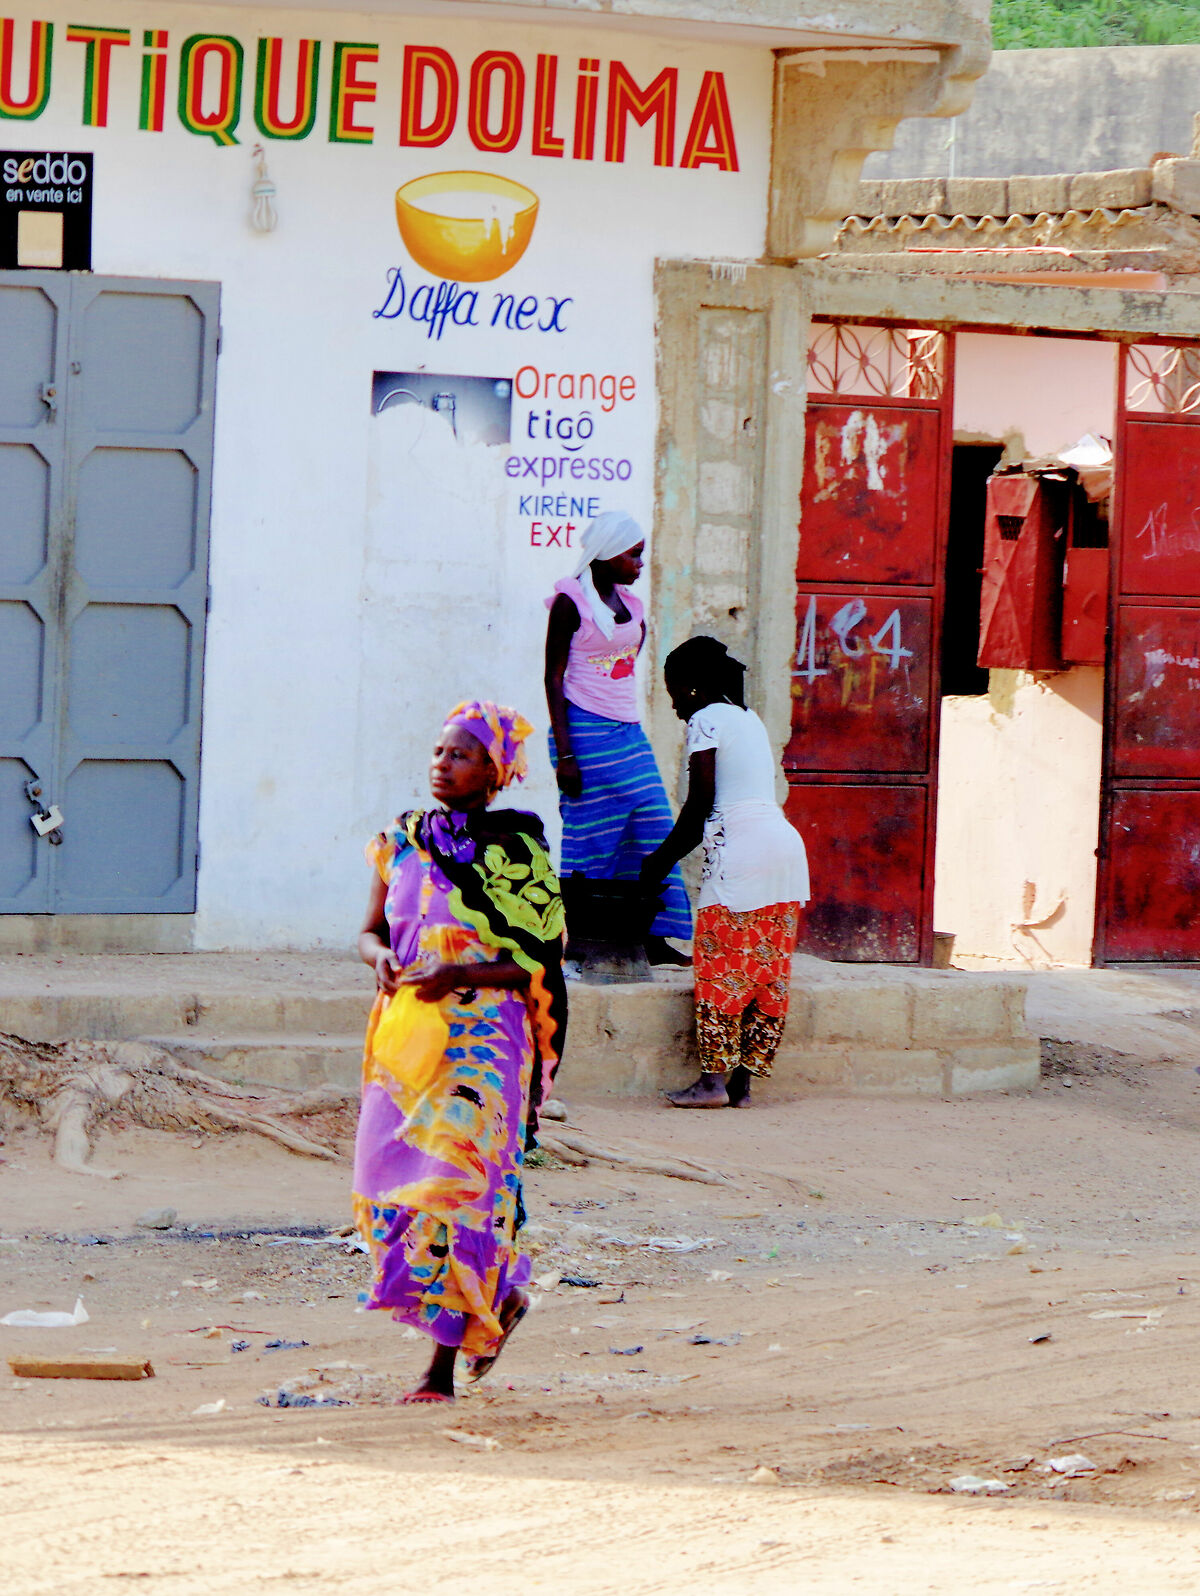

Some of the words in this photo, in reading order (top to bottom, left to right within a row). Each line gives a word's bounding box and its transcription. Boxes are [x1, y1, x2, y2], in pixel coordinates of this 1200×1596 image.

[3, 153, 86, 185] seddo
[6, 189, 23, 202] en
[26, 188, 64, 203] vente
[67, 187, 82, 203] ici
[372, 266, 479, 341] Daffa
[490, 292, 574, 333] nex
[514, 365, 636, 412] Orange
[504, 455, 632, 488] expresso
[518, 490, 601, 519] KIRÈNE
